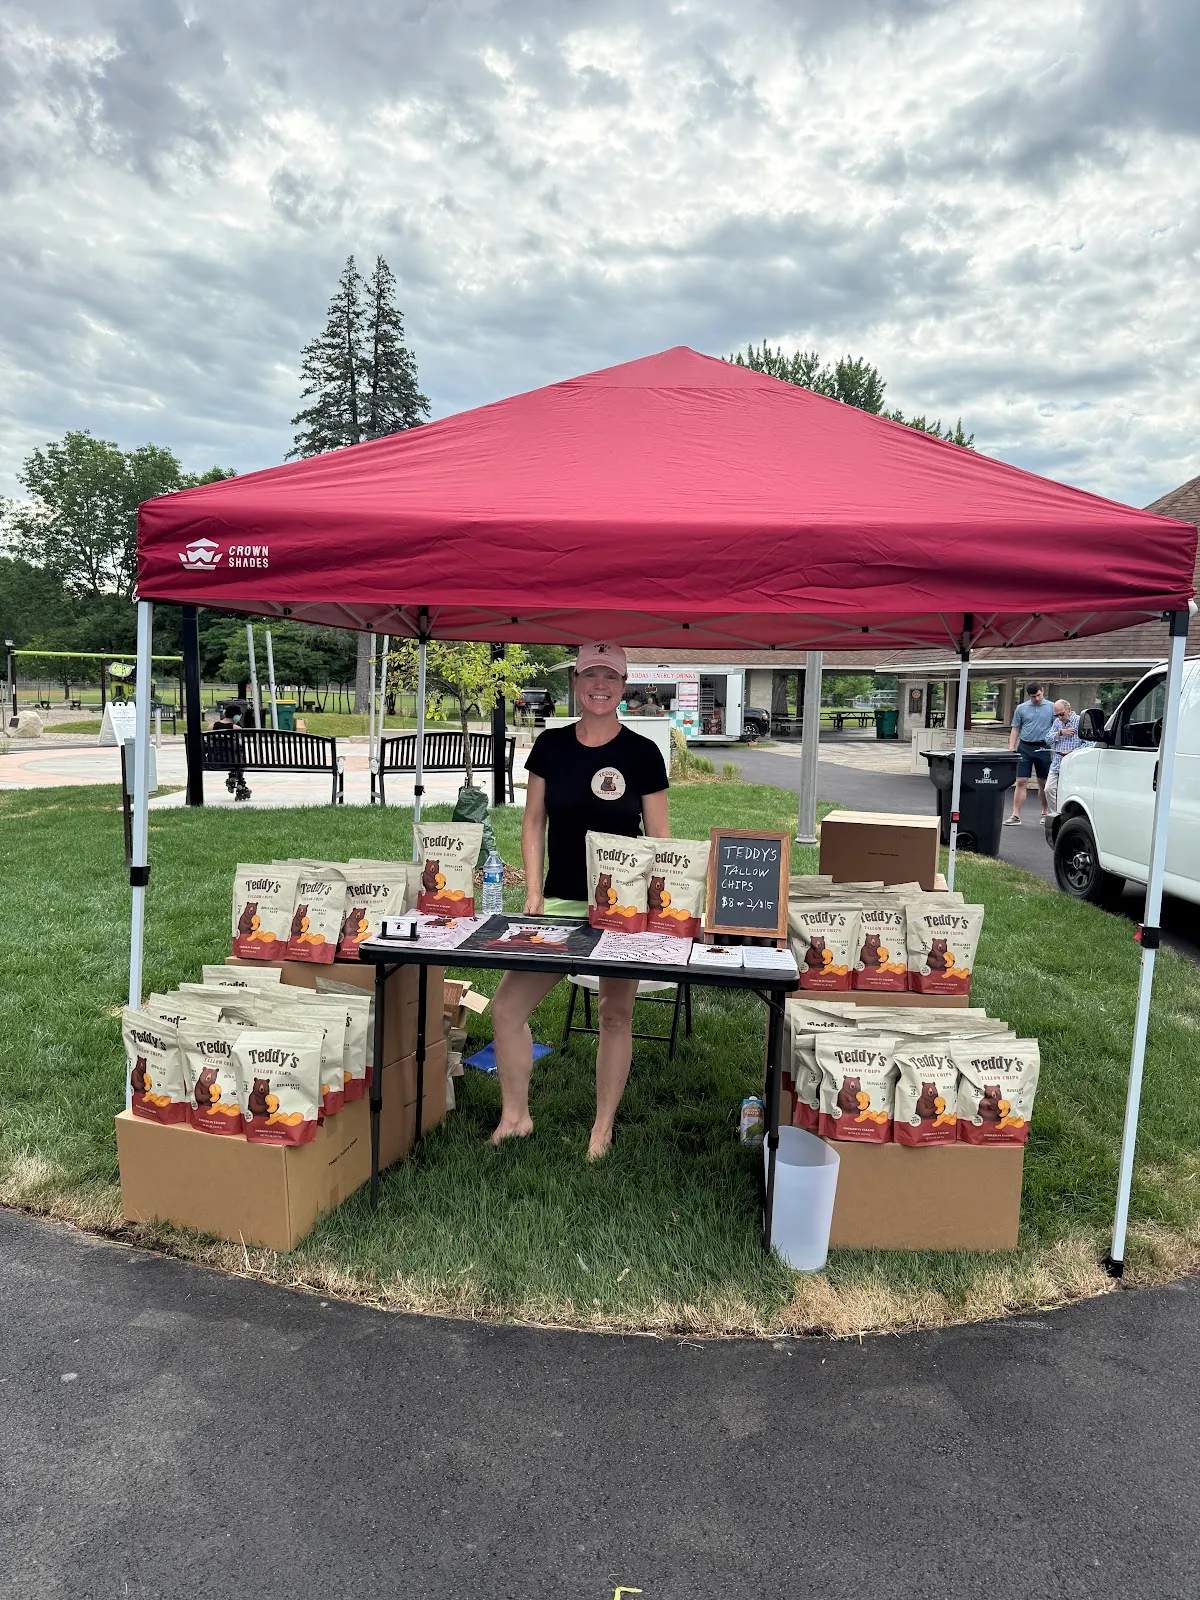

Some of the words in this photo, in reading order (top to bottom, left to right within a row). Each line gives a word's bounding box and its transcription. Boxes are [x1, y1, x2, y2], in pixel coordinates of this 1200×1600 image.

[228, 546, 269, 557] CROWN
[228, 557, 269, 568] SHADES
[422, 835, 465, 851] Teddy's
[596, 848, 638, 868] Teddy's
[655, 851, 691, 869] eddy's
[723, 845, 777, 862] TEDDY'S
[723, 864, 770, 877] TALLOW
[245, 878, 281, 893] Teddy's
[300, 881, 332, 896] Teddy's
[346, 883, 390, 898] Teddy's
[721, 879, 754, 892] CHIPS
[721, 895, 734, 909] $8
[800, 911, 846, 926] Teddy's
[923, 914, 969, 929] Teddy's
[130, 1029, 167, 1051] Teddy's
[196, 1040, 234, 1058] Teddy
[248, 1048, 300, 1069] Teddy's
[834, 1049, 888, 1067] Teddy's
[908, 1053, 954, 1070] Teddy's
[970, 1055, 1024, 1073] Teddy's
